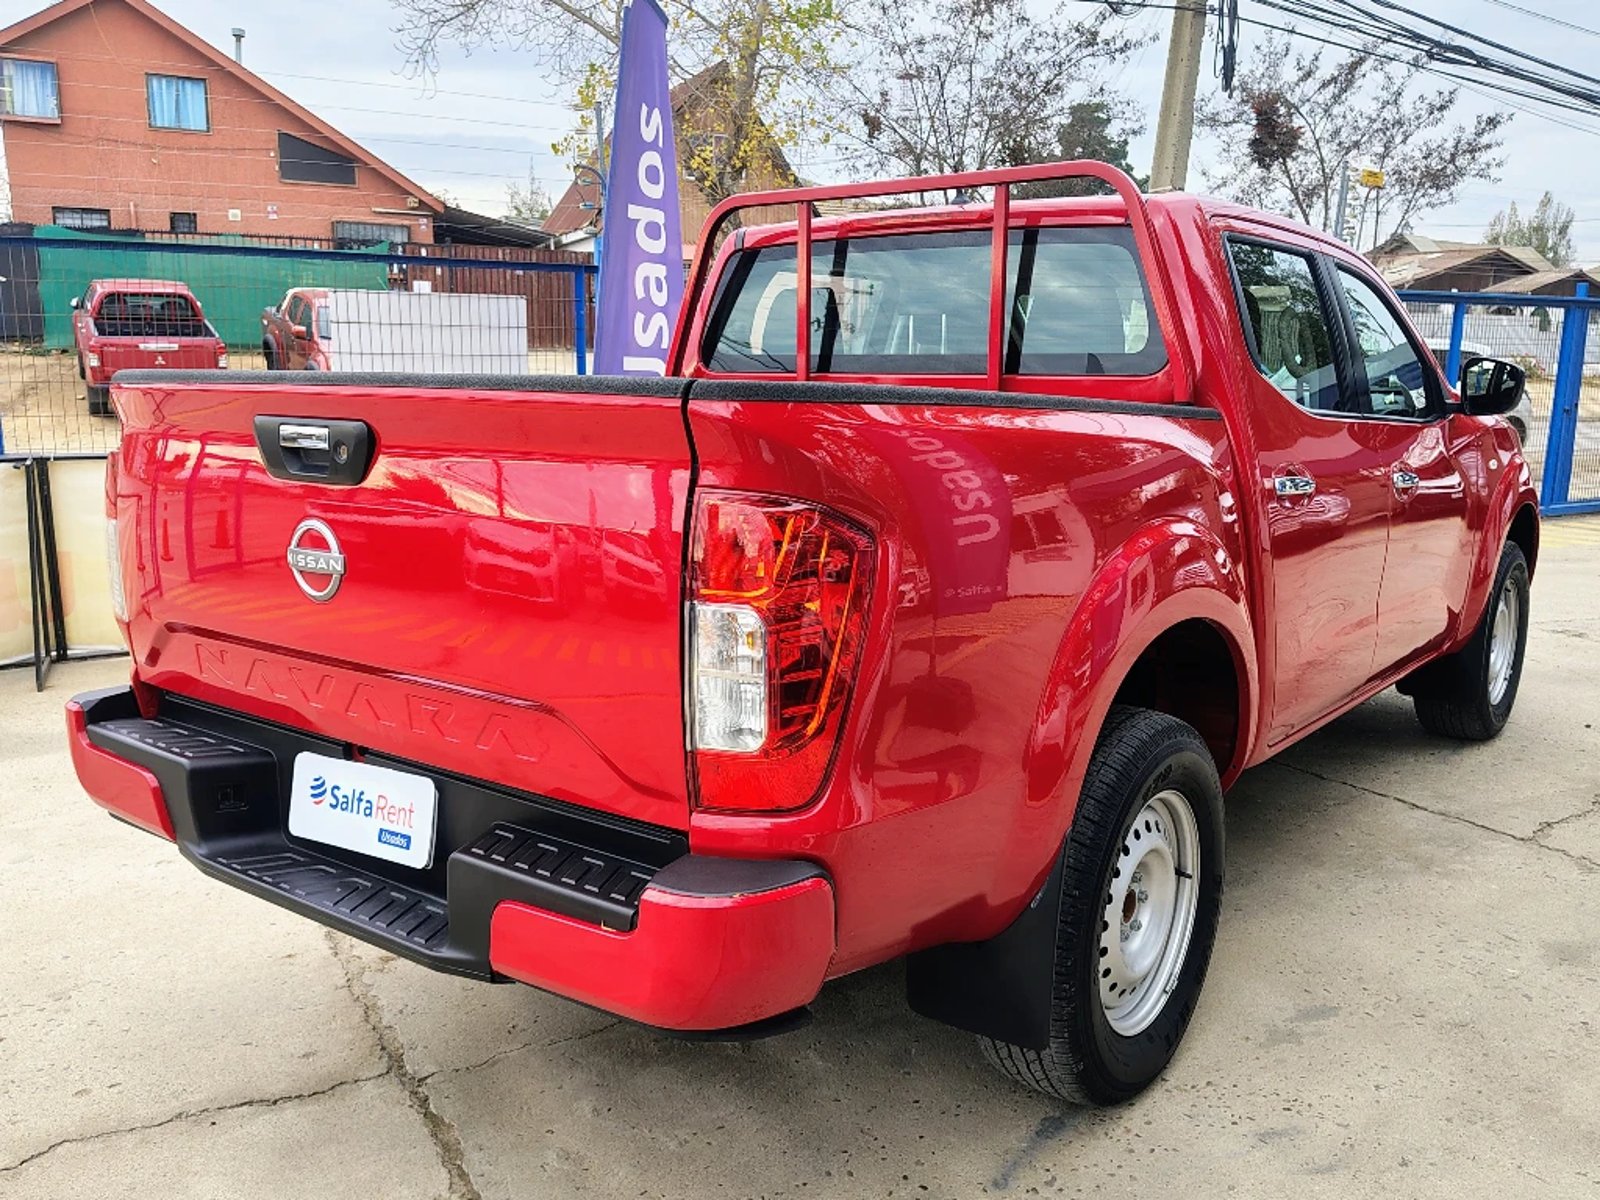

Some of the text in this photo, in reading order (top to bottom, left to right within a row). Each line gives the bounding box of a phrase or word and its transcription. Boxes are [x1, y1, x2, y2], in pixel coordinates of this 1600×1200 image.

[287, 550, 342, 571] NISSAN
[194, 643, 548, 762] NAVARA
[380, 830, 408, 848] Usados
